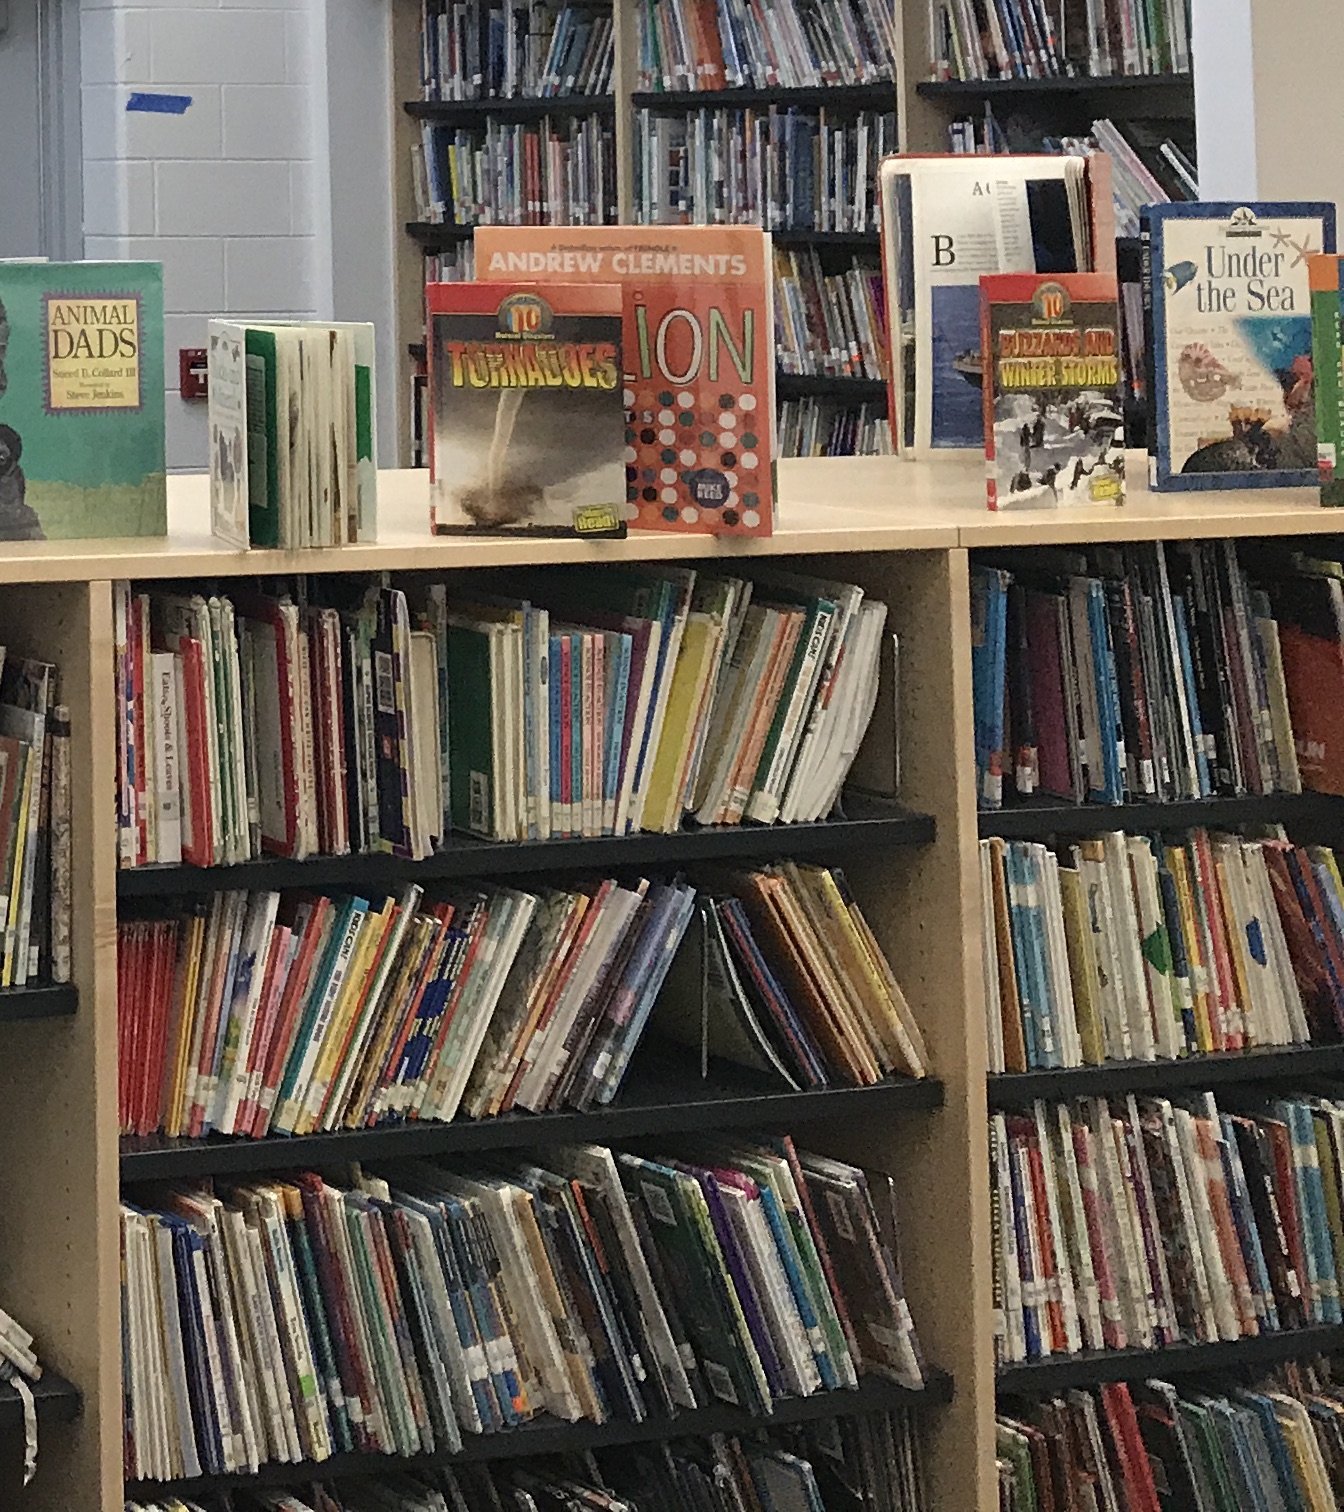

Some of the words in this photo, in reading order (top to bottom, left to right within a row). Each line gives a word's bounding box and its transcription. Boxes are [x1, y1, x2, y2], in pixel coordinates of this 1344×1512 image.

[488, 252, 604, 274] ANDREW
[612, 252, 748, 276] CLEMENTS
[1204, 245, 1286, 279] Under
[1196, 281, 1237, 313] the
[1246, 279, 1296, 313] Sea
[51, 304, 135, 326] ANIMAL
[509, 304, 541, 333] 10
[52, 327, 137, 359] DADS
[1085, 327, 1115, 357] AND
[447, 341, 618, 389] TORNADOES
[999, 357, 1057, 387] WINTER
[1060, 356, 1118, 386] STORMS
